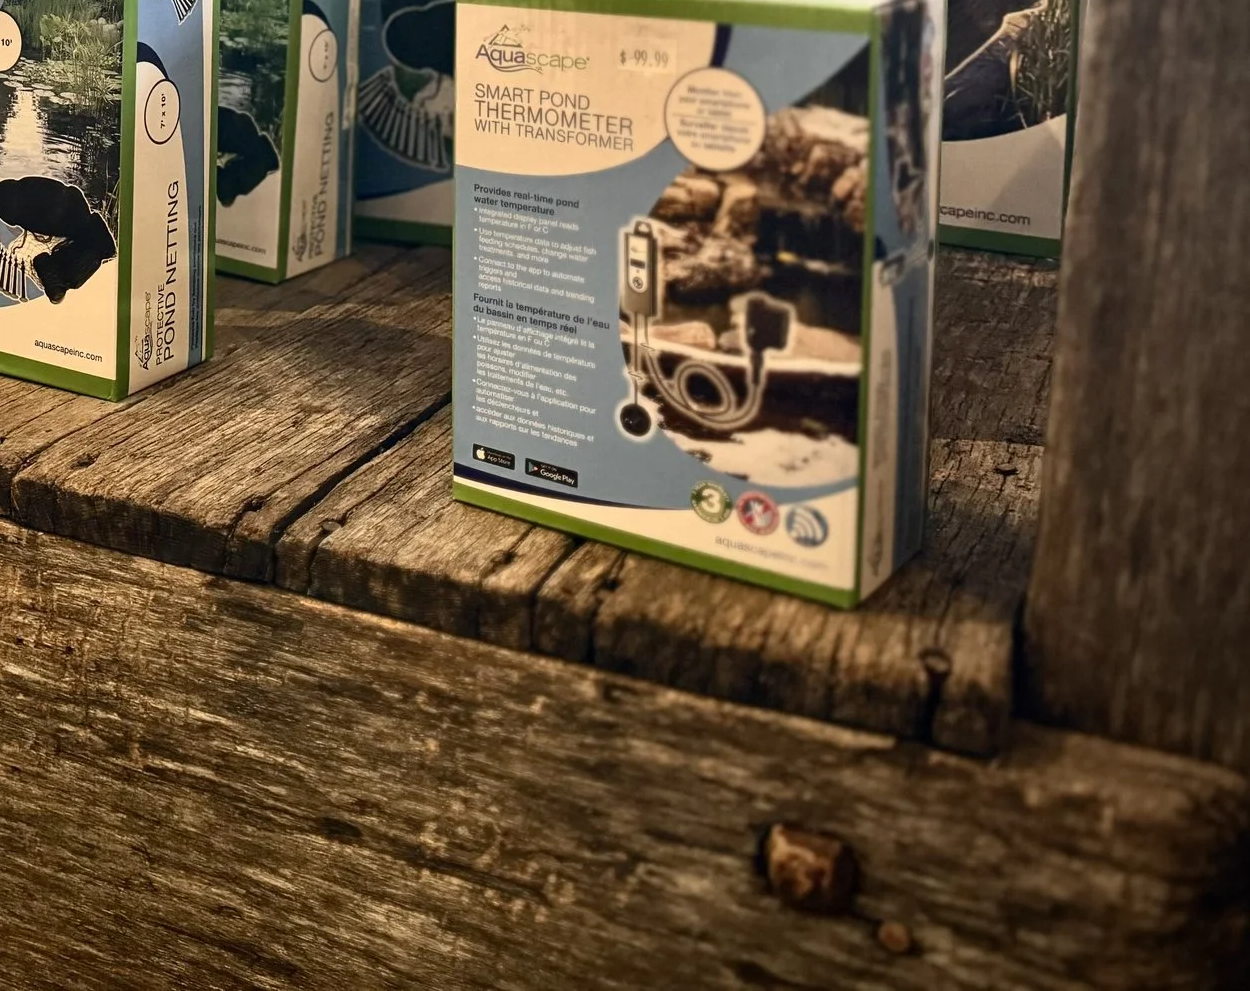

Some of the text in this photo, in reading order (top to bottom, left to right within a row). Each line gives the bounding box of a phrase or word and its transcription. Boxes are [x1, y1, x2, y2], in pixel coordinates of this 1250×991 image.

[475, 44, 590, 71] Aquascape
[634, 49, 669, 68] 99.99
[474, 83, 591, 110] SMART POND
[474, 99, 633, 136] THERMOMETER
[474, 119, 634, 152] WITH TRANSFORMER
[314, 111, 334, 256] POND NETTING
[473, 183, 580, 209] Provides real-time pond
[473, 196, 555, 216] water temperature
[940, 205, 1031, 226] capeinc.com
[164, 180, 179, 361] POND NETTING
[473, 293, 504, 307] Fournit
[516, 301, 571, 321] température
[572, 313, 585, 325] de
[587, 317, 610, 329] l'eau
[486, 307, 514, 320] bassin
[529, 316, 557, 330] temps
[560, 323, 577, 334] réel
[142, 292, 153, 371] Aquascape
[34, 339, 103, 362] aquascapeinc.com
[540, 469, 575, 485] Google Play
[701, 488, 721, 513] 3
